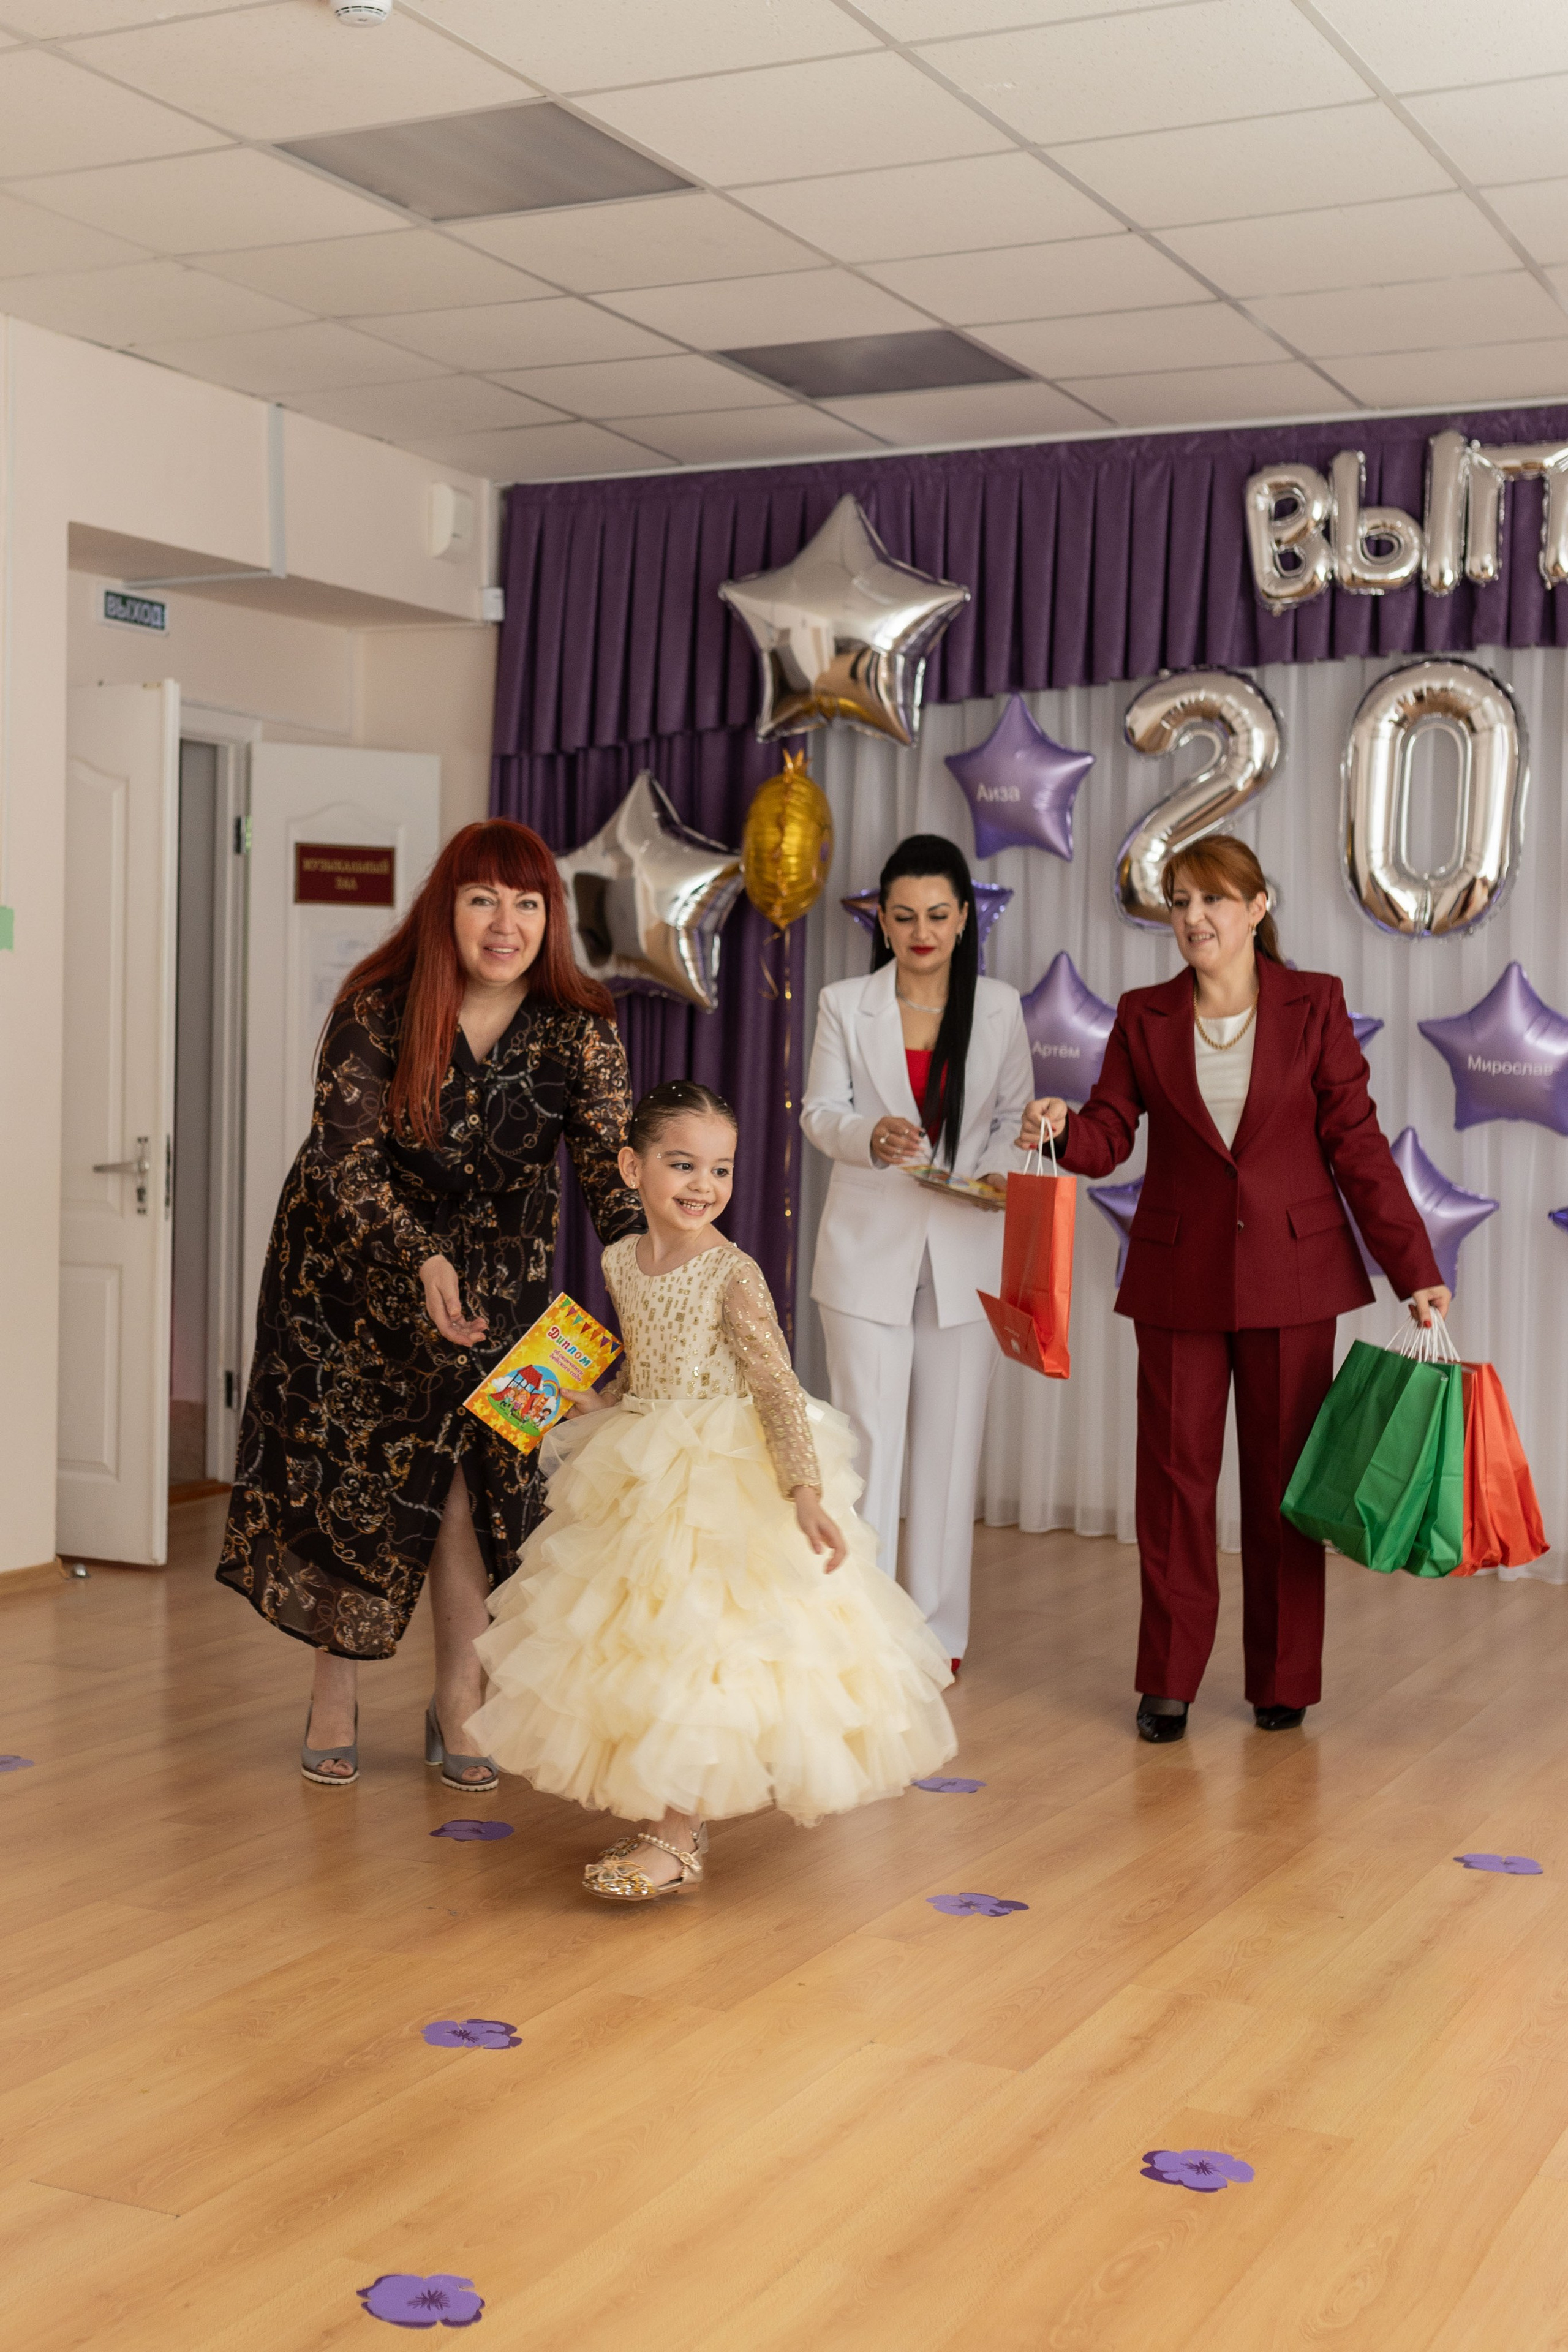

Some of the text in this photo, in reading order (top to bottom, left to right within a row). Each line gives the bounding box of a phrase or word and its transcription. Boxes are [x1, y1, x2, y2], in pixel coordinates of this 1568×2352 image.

[107, 595, 163, 626] ВЫХОД
[976, 783, 1021, 802] Аиза
[1031, 1041, 1080, 1060] Артём
[1468, 1053, 1554, 1077] Мирослав
[547, 1325, 593, 1368] Диплом
[549, 1352, 583, 1383] детского сада
[559, 1354, 584, 1376] окончании
